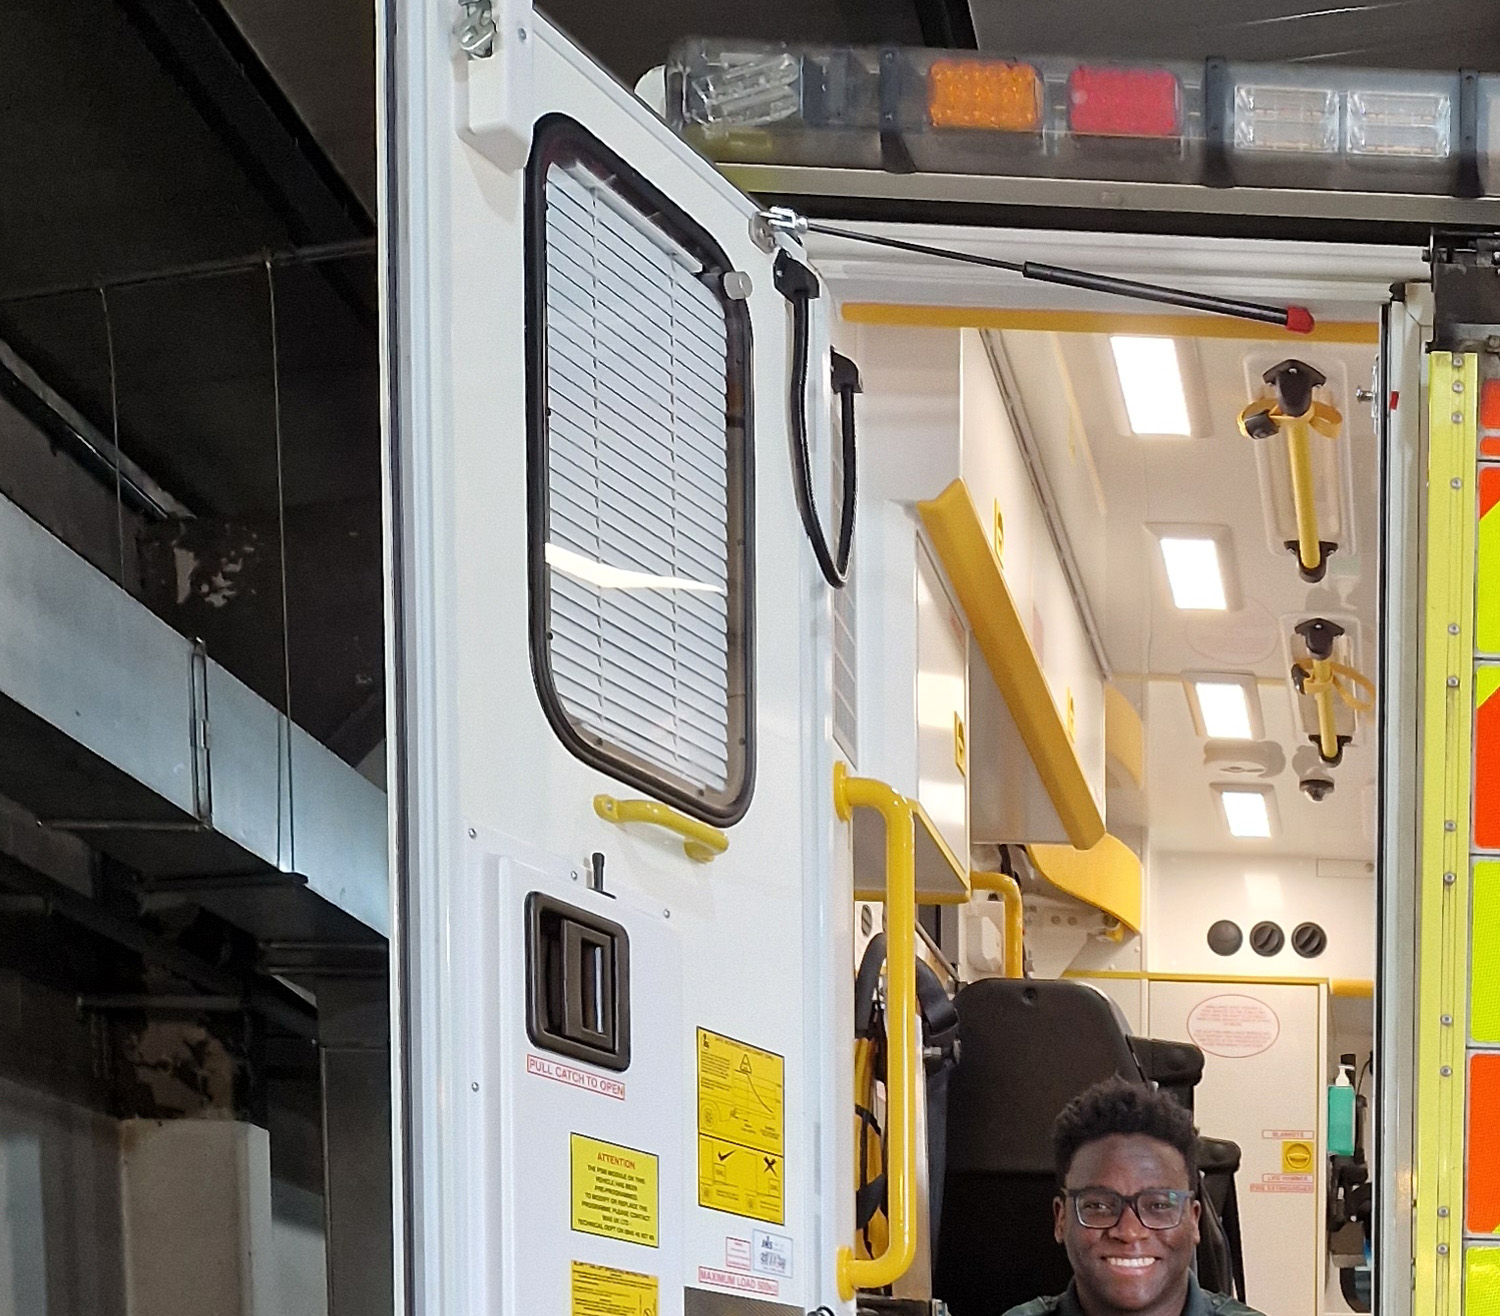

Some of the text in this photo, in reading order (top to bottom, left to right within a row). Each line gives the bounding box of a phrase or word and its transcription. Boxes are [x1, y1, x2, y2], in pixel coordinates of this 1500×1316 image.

[529, 1059, 623, 1095] PULL CATCH TO OPEN
[597, 1152, 635, 1169] ATTENTION
[700, 1269, 735, 1284] MAXIMUM
[736, 1276, 756, 1289] LOAD
